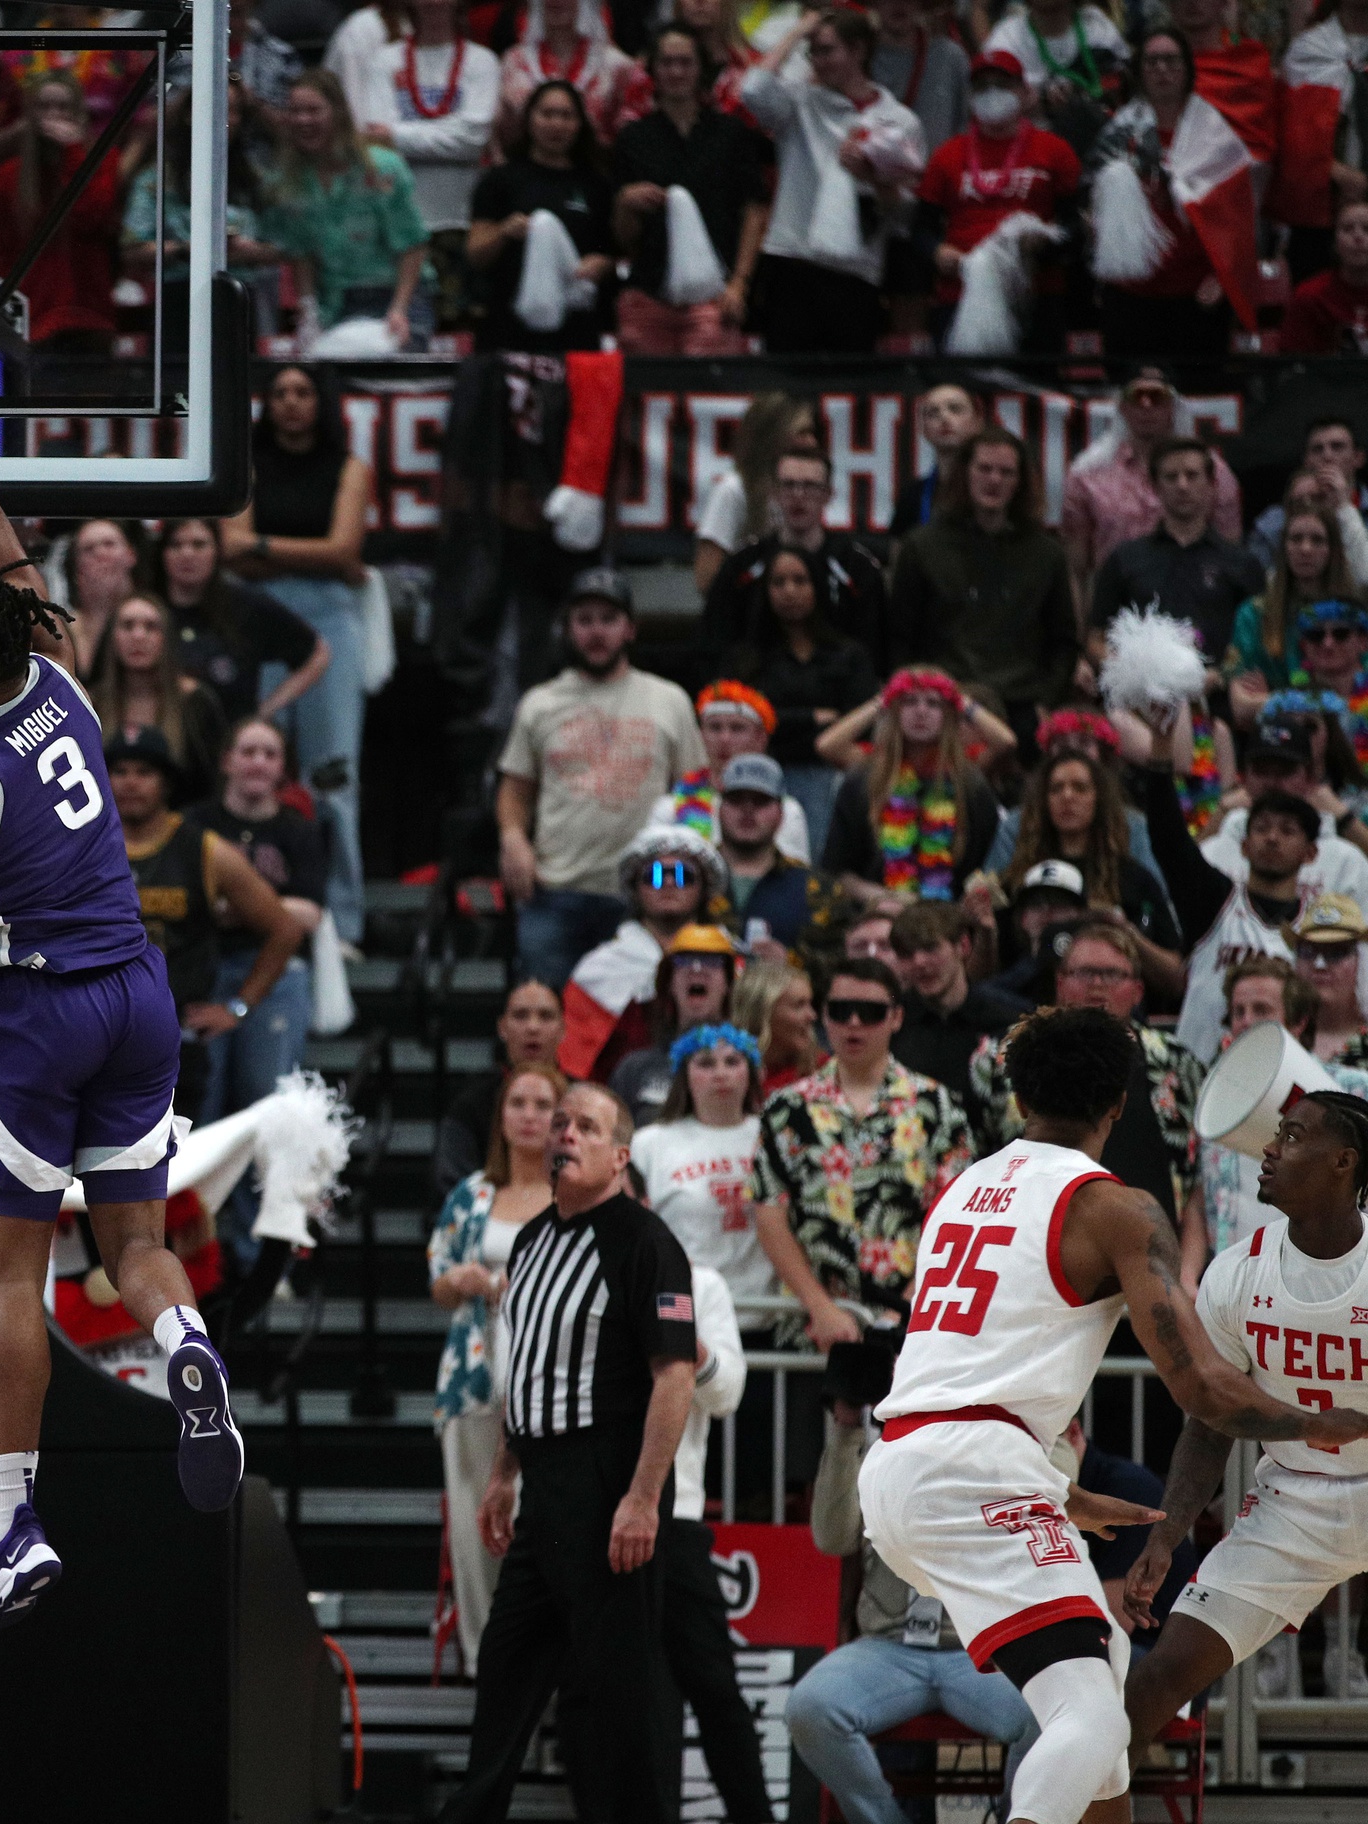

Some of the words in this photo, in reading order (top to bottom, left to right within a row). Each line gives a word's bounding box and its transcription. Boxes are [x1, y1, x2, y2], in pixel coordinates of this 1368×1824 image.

[4, 696, 69, 758] MIGUEL
[36, 735, 104, 831] 3
[962, 1187, 1018, 1213] ARMS
[906, 1223, 1018, 1337] 25
